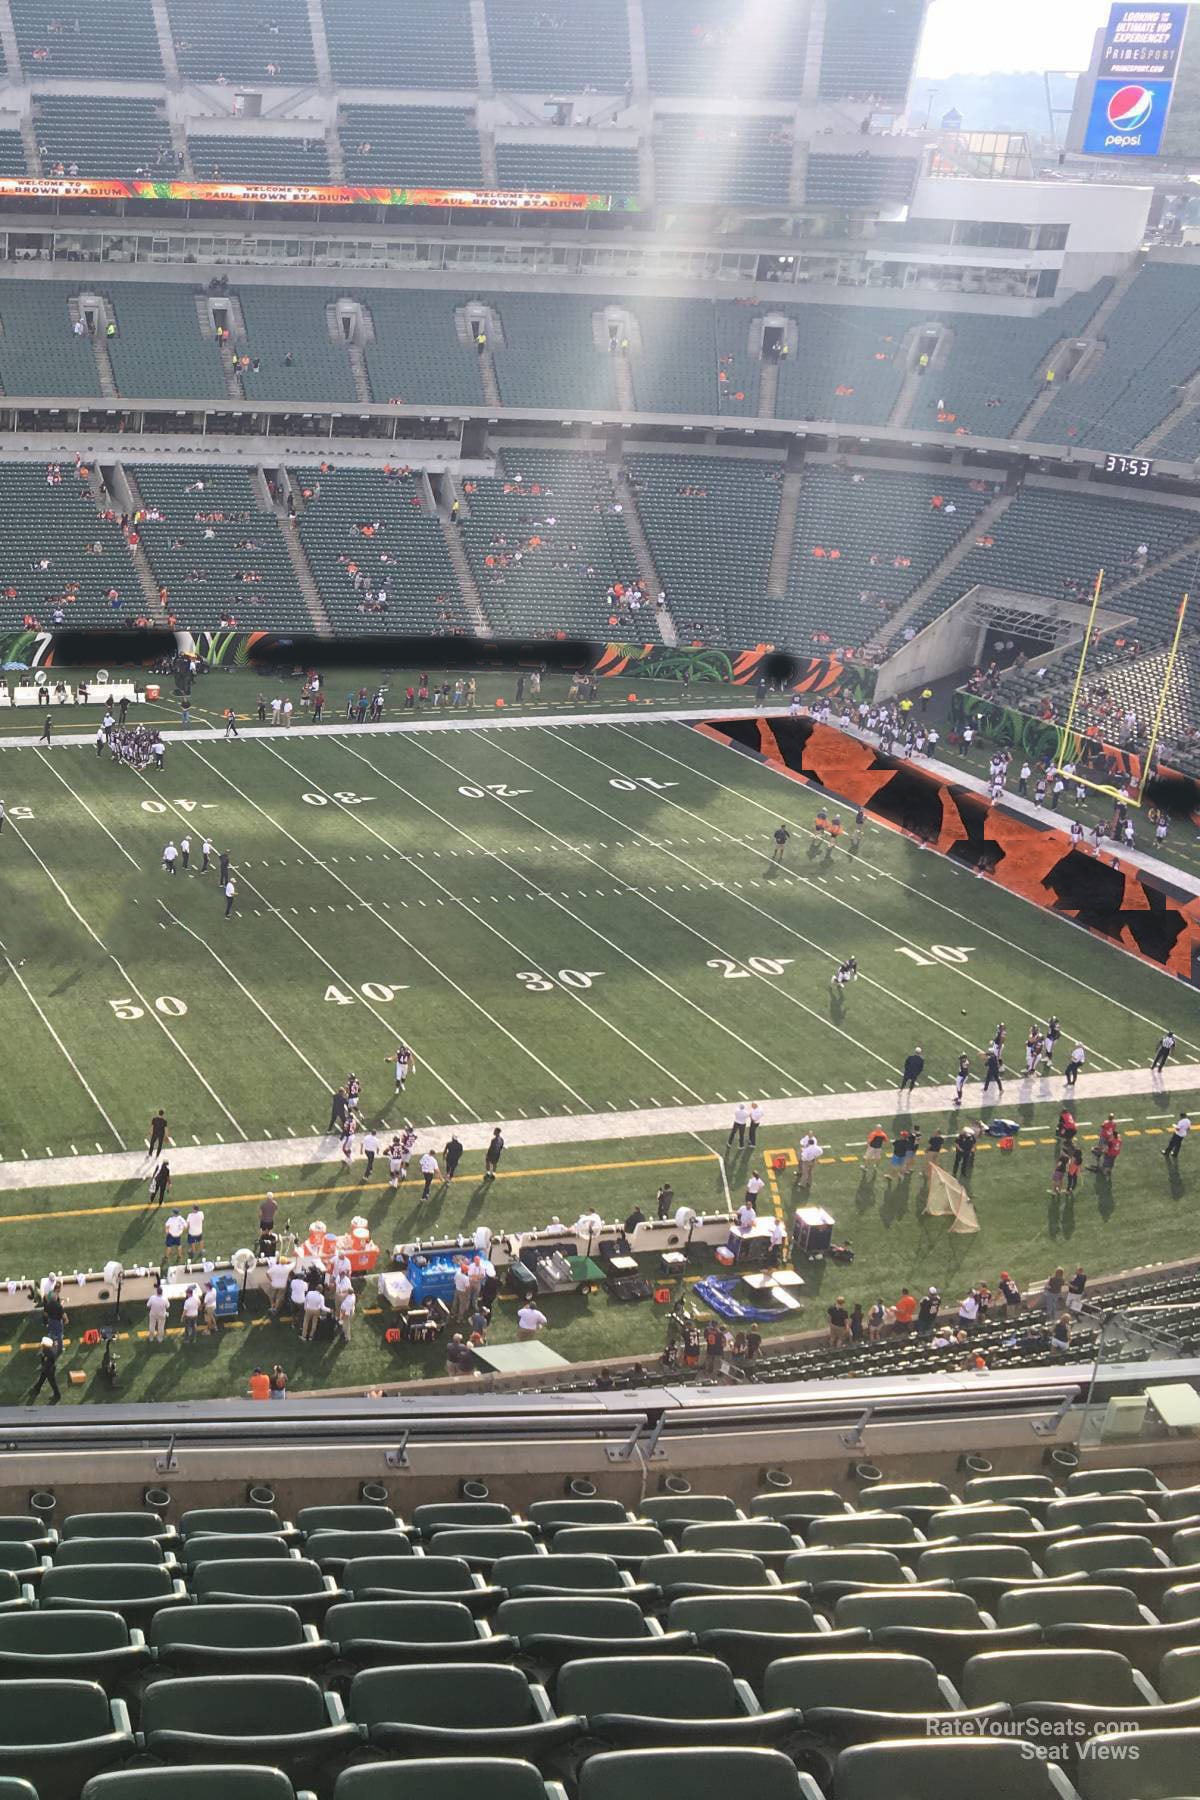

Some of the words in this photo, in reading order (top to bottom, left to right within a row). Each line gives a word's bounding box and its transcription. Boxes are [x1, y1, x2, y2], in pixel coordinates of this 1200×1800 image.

[1123, 12, 1160, 21] LOOKING
[1116, 22, 1156, 32] ULTIMATE
[1157, 23, 1173, 32] VIP
[1113, 32, 1170, 43] EXPERIENCE?
[1105, 134, 1141, 147] pepsi
[65, 188, 122, 196] STADIUM
[524, 200, 582, 208] STADIUM
[1106, 457, 1150, 477] 37:53
[894, 944, 969, 966] 10
[706, 956, 785, 979] 20
[516, 968, 593, 991] 30
[324, 982, 395, 1005] 40
[109, 996, 188, 1020] 50
